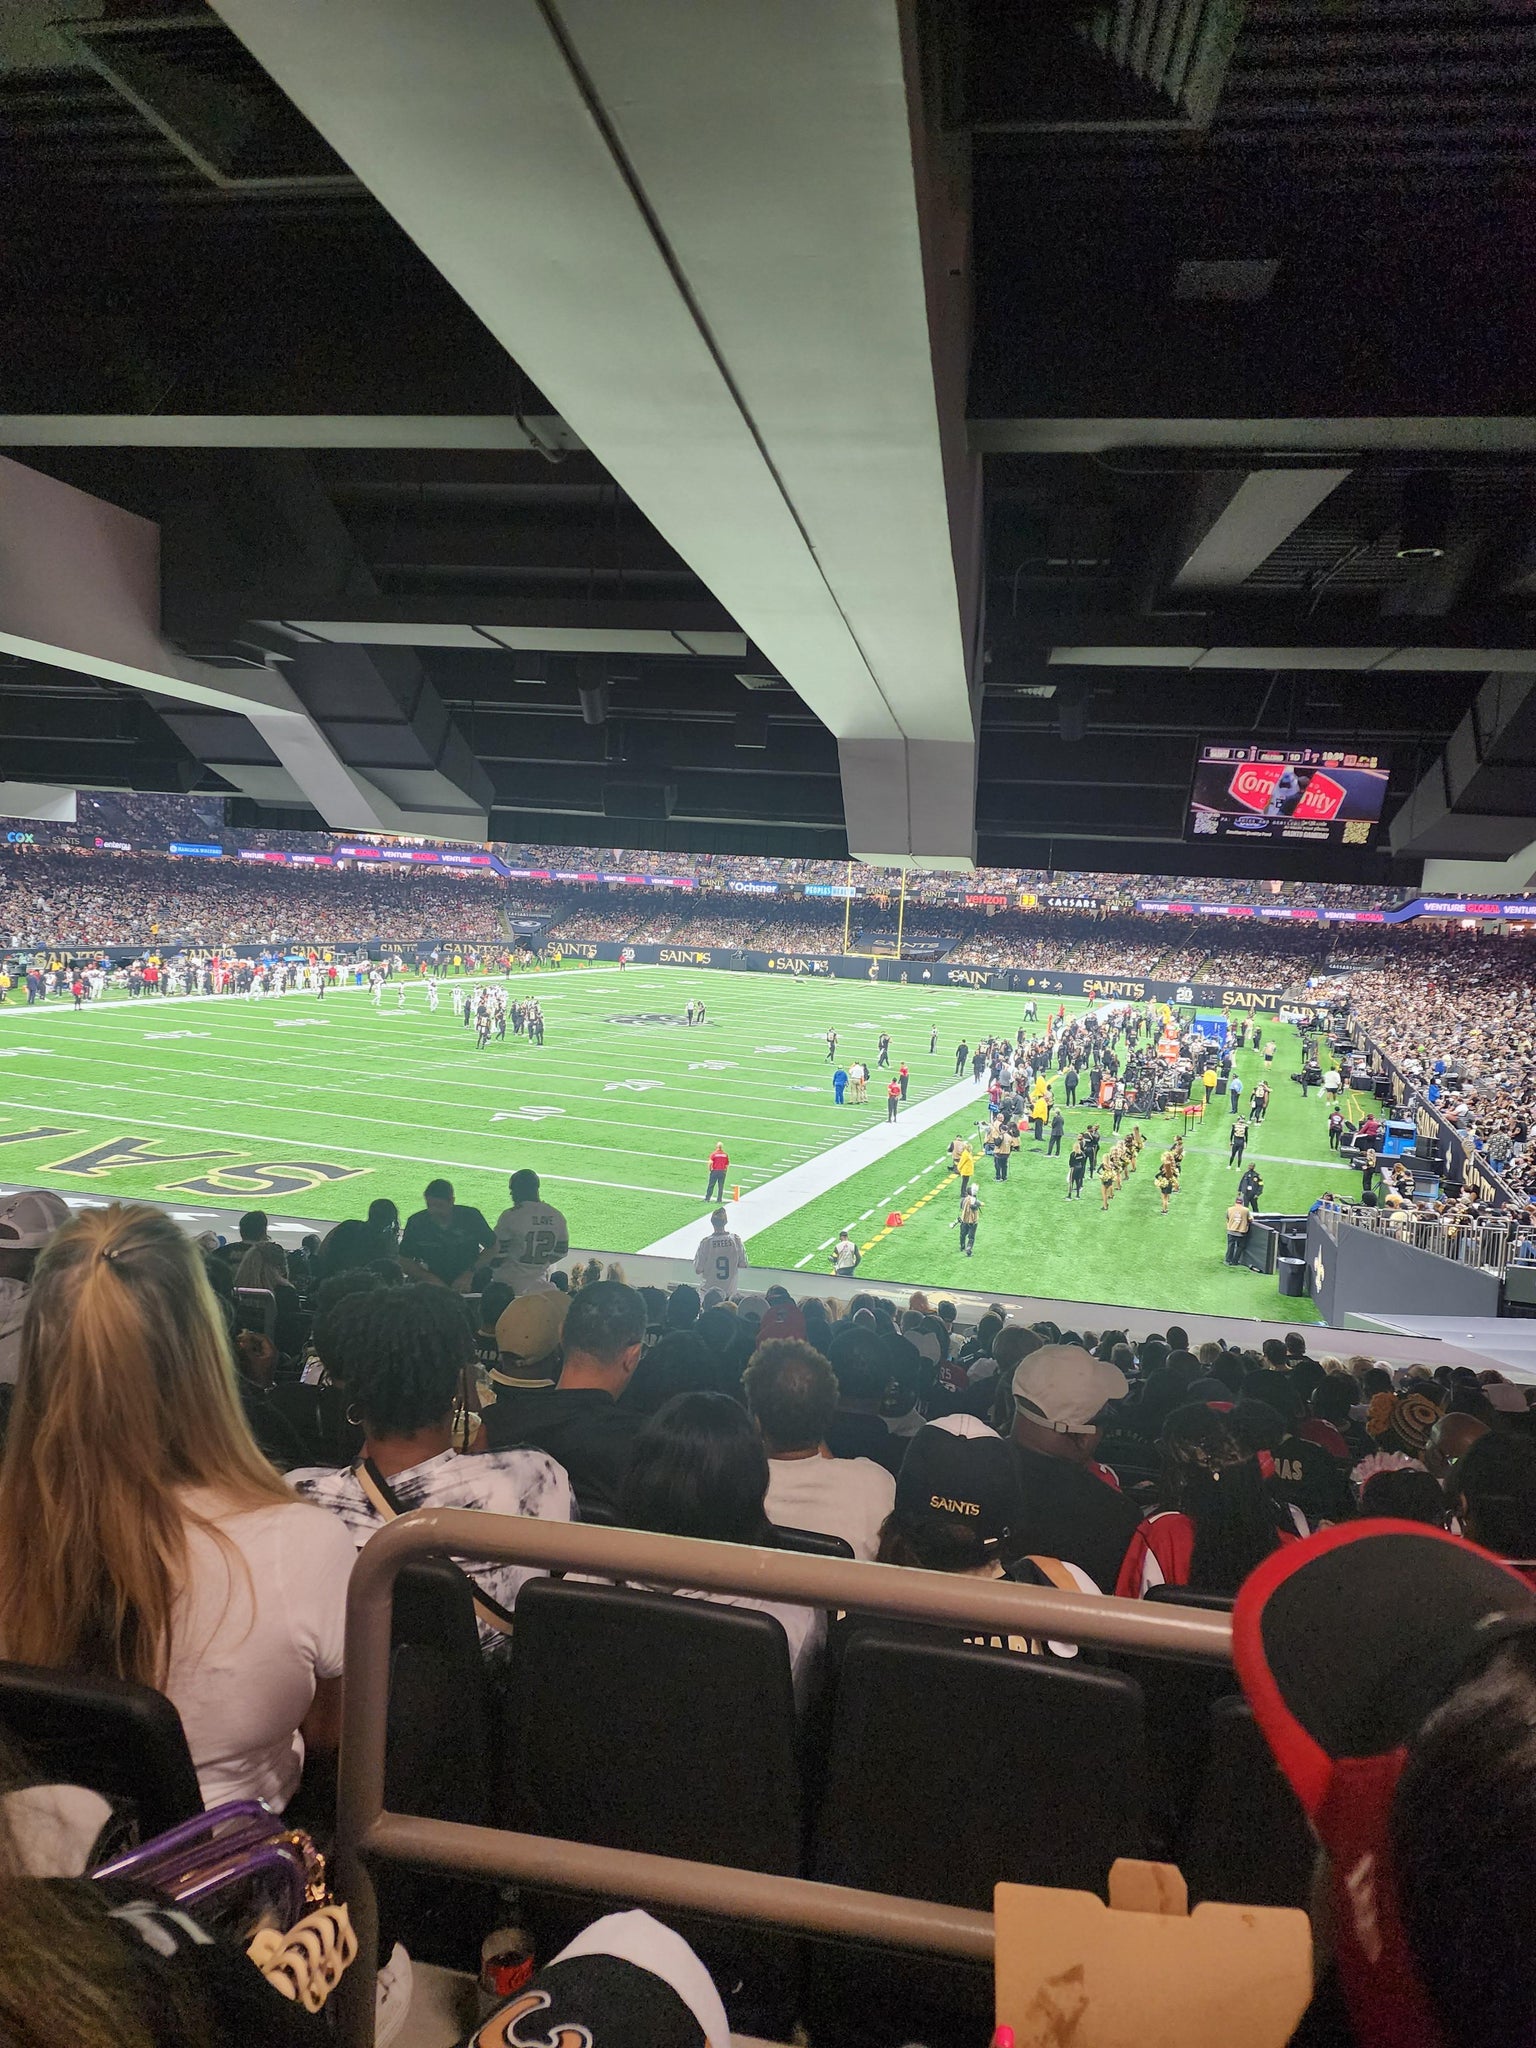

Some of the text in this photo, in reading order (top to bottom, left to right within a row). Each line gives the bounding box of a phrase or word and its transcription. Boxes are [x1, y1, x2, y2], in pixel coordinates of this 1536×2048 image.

[7, 832, 34, 843] COX
[52, 836, 80, 845] SAINTS
[383, 851, 412, 859] VENTURE
[442, 855, 471, 863] VENTURE
[735, 882, 777, 893] Ochsner
[805, 886, 831, 895] PEOPLES
[965, 894, 1007, 905] verizon
[1023, 895, 1035, 905] 33
[1048, 898, 1096, 908] CAESARS
[1106, 899, 1134, 907] SAINTS
[1424, 902, 1500, 913] VENTURE GLOBAL
[1503, 905, 1536, 914] VENTUR
[547, 942, 597, 956] SAINTS
[874, 939, 940, 949] SAINTS
[1083, 980, 1145, 997] SAINTS
[1222, 991, 1283, 1009] SAINT
[489, 1105, 567, 1121] 10
[716, 1256, 730, 1280] 9
[930, 1495, 980, 1516] SAINTS
